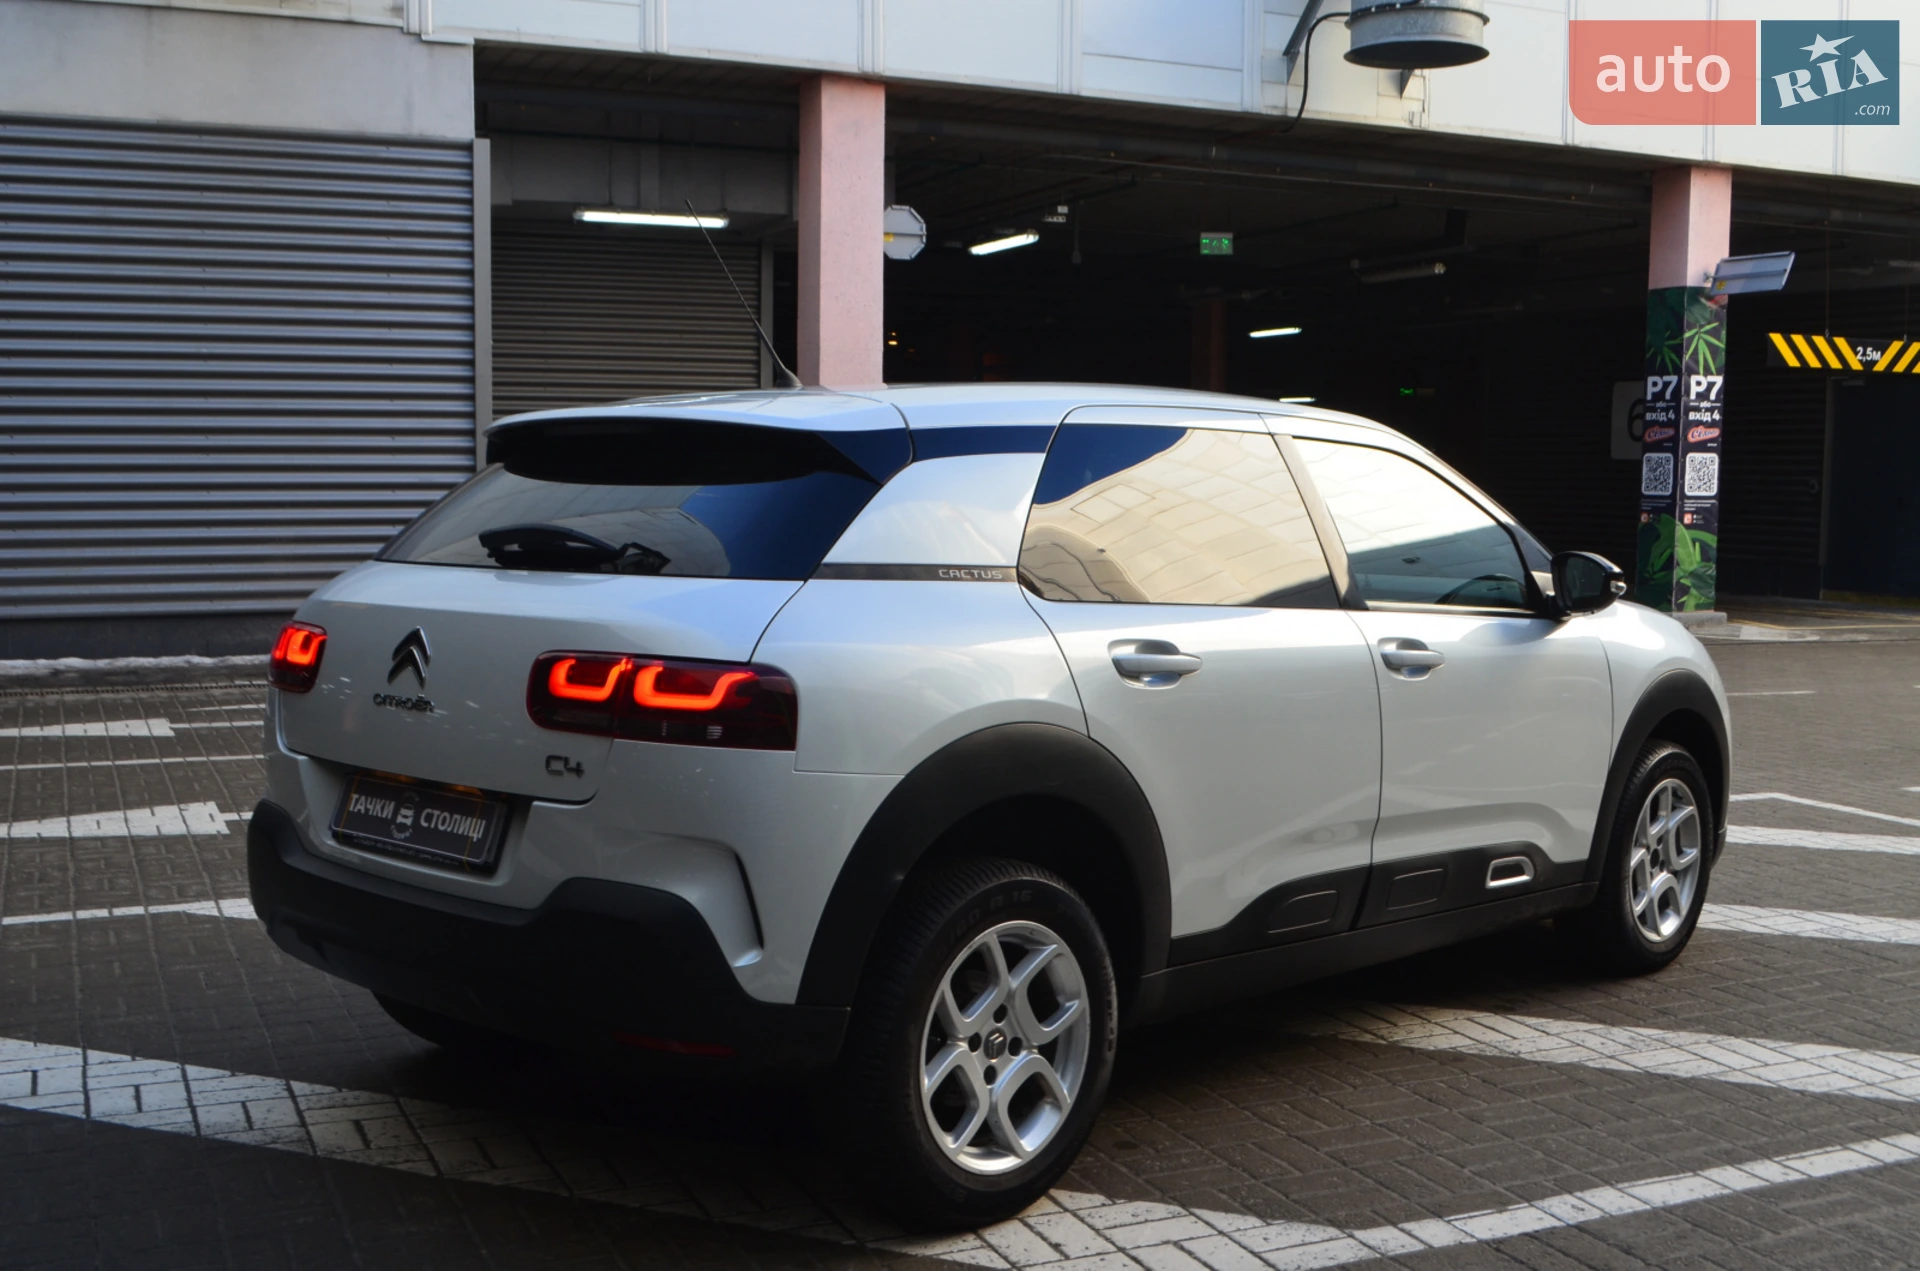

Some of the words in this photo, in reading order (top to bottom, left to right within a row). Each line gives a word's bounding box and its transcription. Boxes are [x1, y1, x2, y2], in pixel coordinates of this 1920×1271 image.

[1646, 375, 1678, 400] P7
[1689, 374, 1724, 400] P7
[1645, 409, 1667, 422] вхід
[1668, 409, 1675, 420] 4
[1688, 409, 1711, 422] вхід
[1712, 409, 1720, 421] 4
[938, 569, 1003, 580] CACTUS
[545, 754, 585, 779] C4
[348, 793, 396, 821] ТАЧКИ
[419, 807, 487, 843] СТОЛИЦІ
